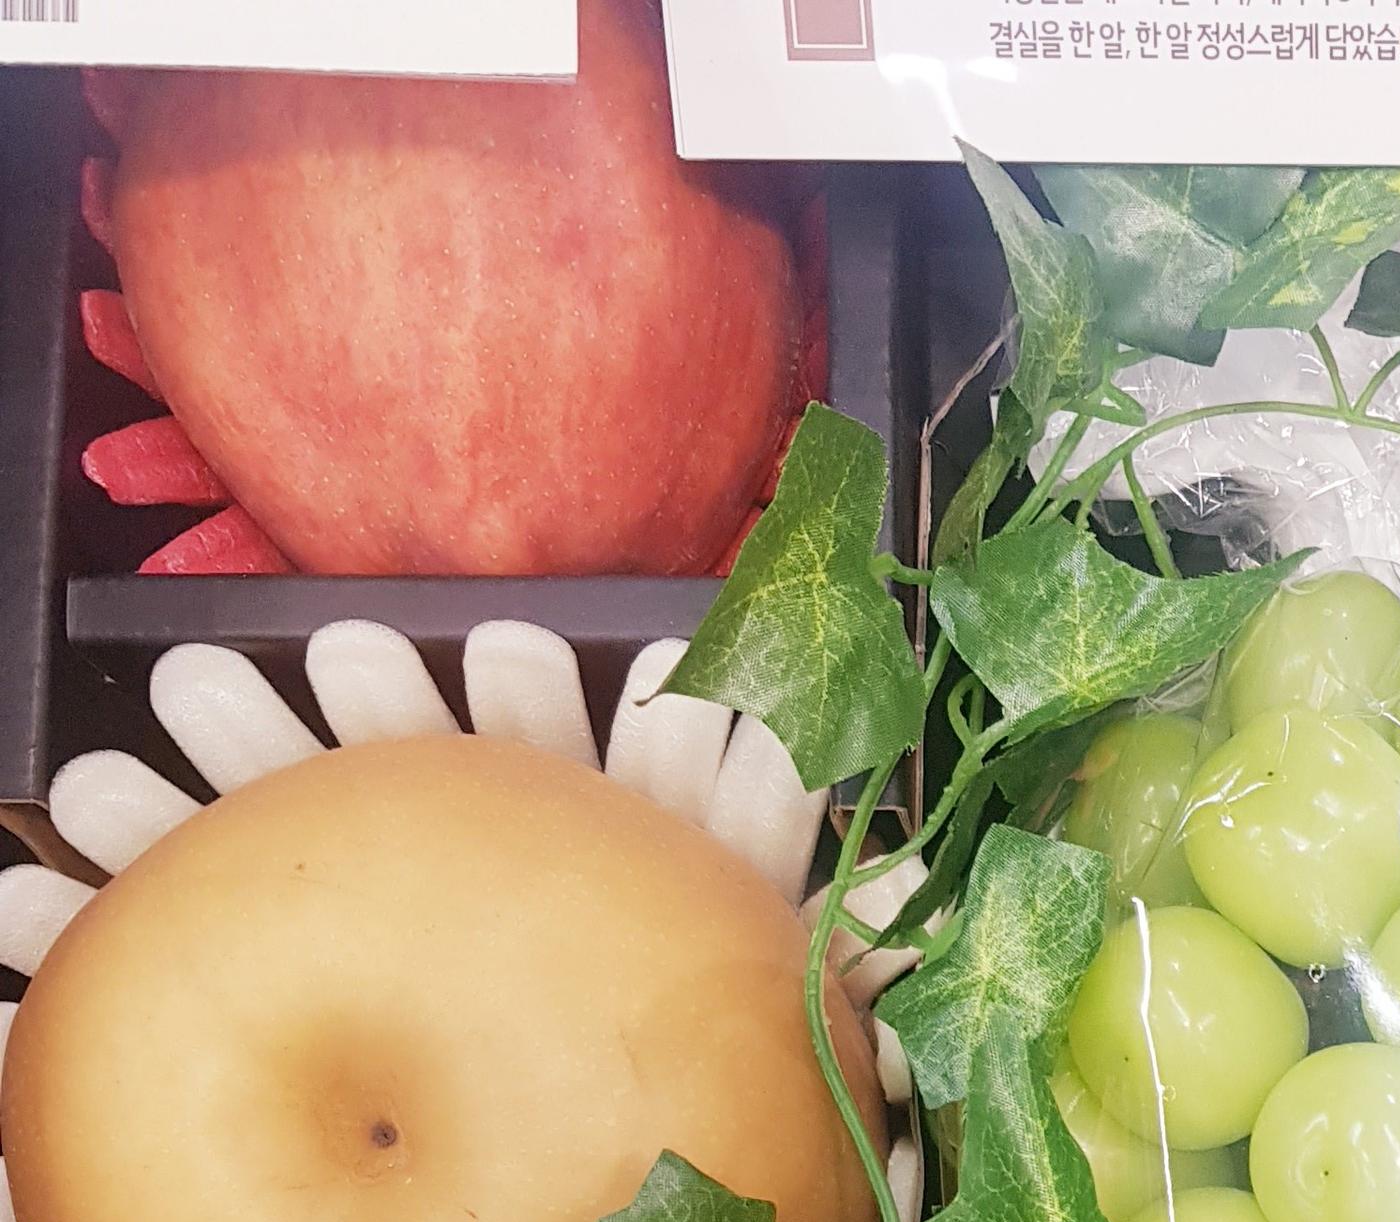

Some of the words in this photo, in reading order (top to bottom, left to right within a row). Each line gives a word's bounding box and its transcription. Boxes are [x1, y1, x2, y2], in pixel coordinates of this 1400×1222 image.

[989, 20, 1064, 59] 결실을
[1068, 20, 1095, 59] 한
[1098, 20, 1131, 60] 알,
[1134, 20, 1162, 59] 한
[1165, 21, 1193, 60] 알
[1196, 21, 1320, 61] 정성스럽게
